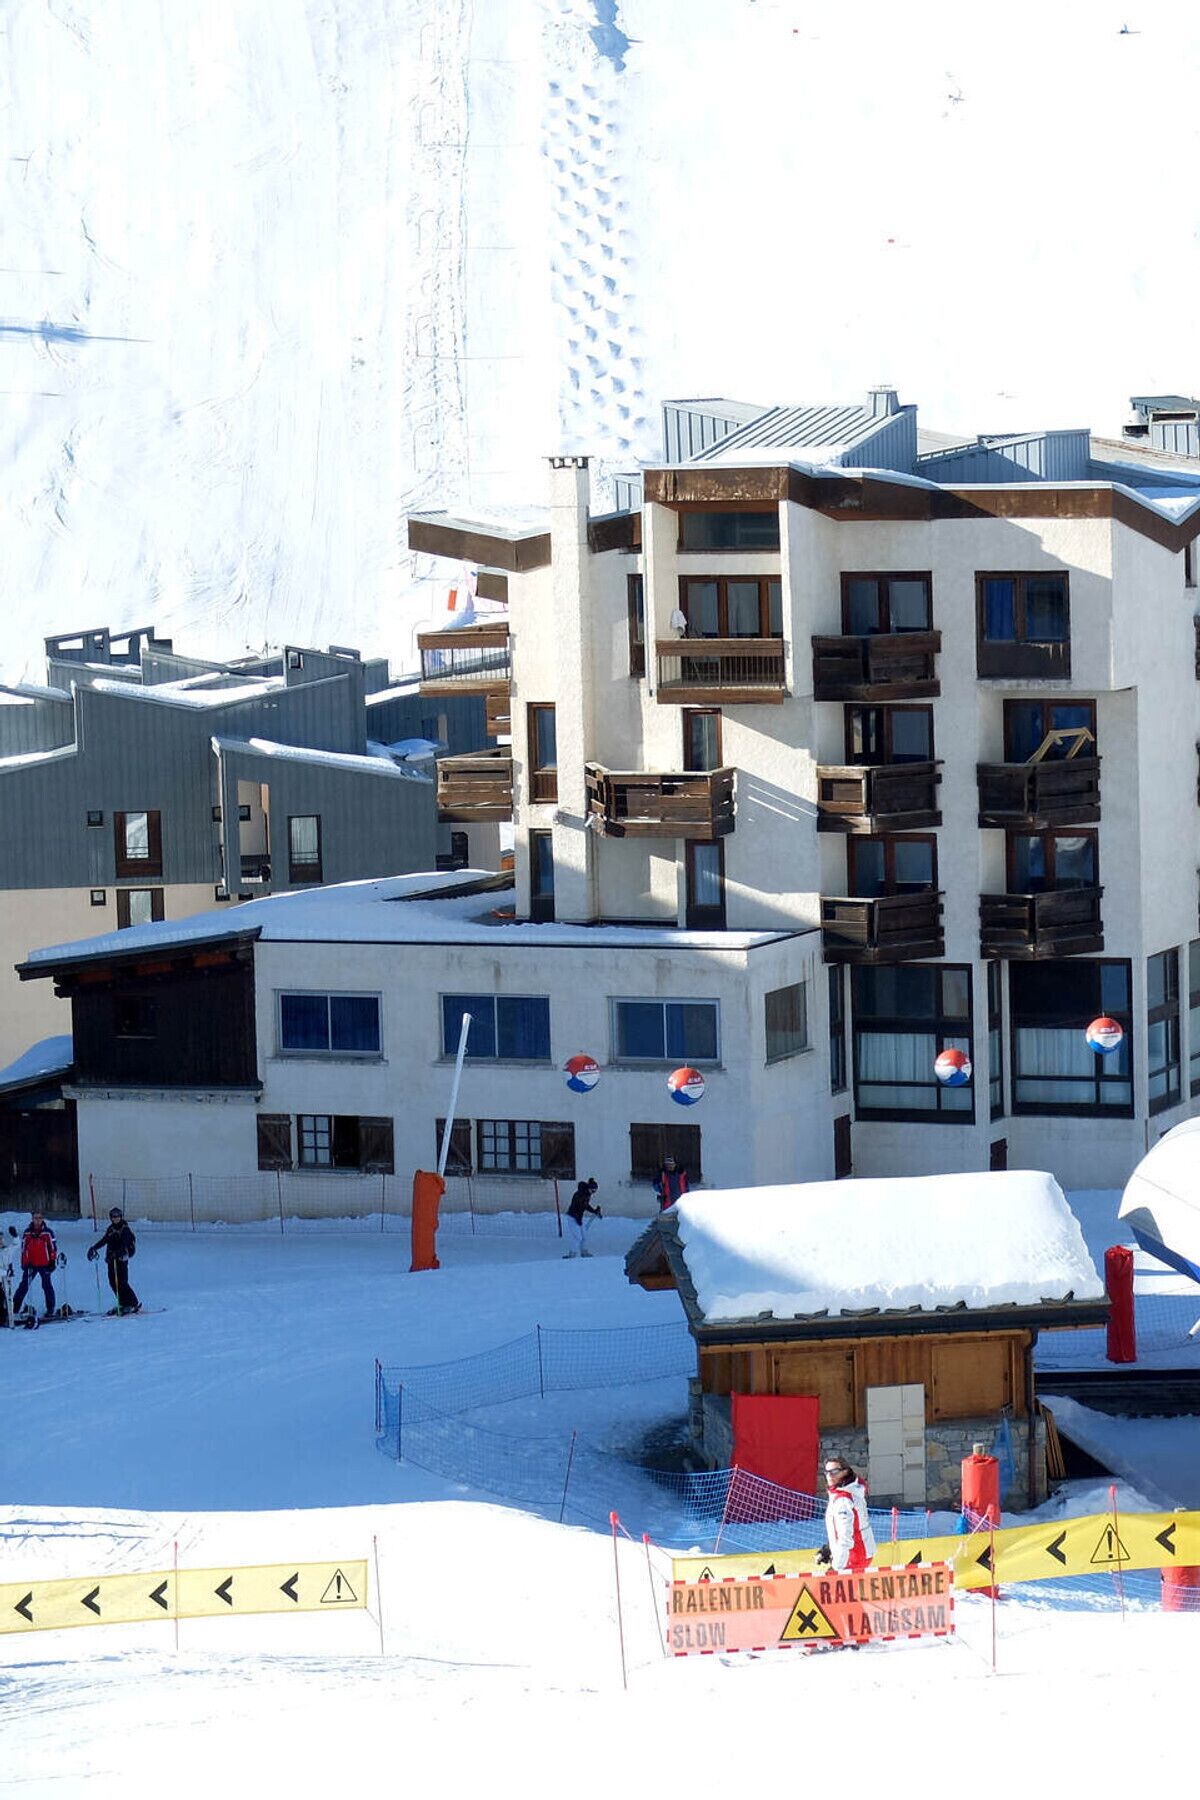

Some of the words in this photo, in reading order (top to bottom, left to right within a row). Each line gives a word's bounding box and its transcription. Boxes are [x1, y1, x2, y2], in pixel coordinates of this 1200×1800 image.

[672, 1585, 764, 1613] RALENTIR
[820, 1571, 944, 1604] RALLENTARE
[673, 1622, 725, 1648] SLOW
[848, 1604, 945, 1636] LANGSAM
